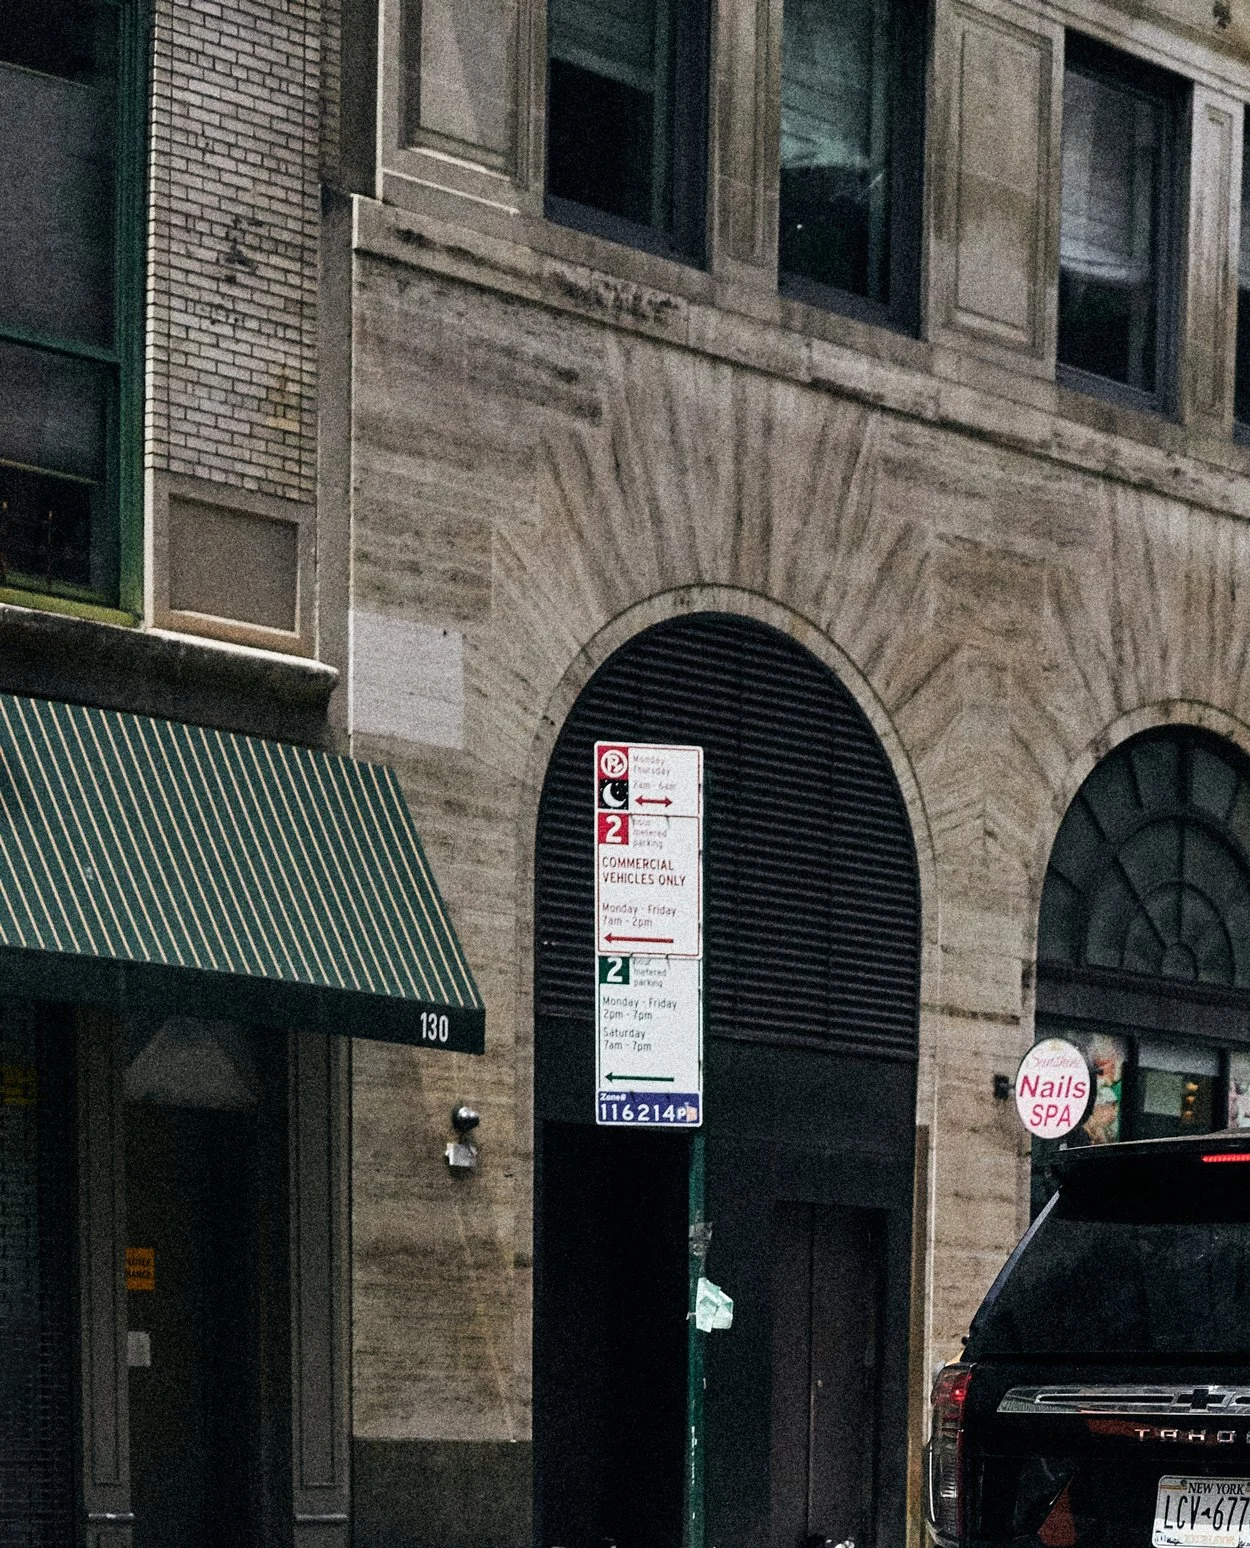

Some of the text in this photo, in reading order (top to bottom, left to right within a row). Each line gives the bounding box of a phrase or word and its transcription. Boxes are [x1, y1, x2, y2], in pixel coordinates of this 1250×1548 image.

[606, 814, 622, 843] 2
[632, 829, 667, 838] metered
[633, 840, 663, 849] parking
[602, 856, 675, 871] COMMERCIAL
[602, 871, 686, 887] VEHICLES ONLY
[602, 902, 638, 915] Monday
[648, 904, 677, 917] Friday
[603, 915, 623, 927] 7am
[632, 916, 653, 928] 2pm
[606, 957, 623, 982] 2
[633, 980, 663, 988] parking
[602, 996, 639, 1008] Monday
[648, 997, 677, 1010] Friday
[603, 1009, 623, 1020] 2pm
[633, 1010, 653, 1021] 7pm
[420, 1011, 449, 1043] 130
[603, 1027, 646, 1040] Saturday
[604, 1040, 623, 1051] 7am
[632, 1042, 652, 1053] 7pm
[1019, 1075, 1087, 1099] Nails
[601, 1103, 675, 1122] 116214
[1030, 1104, 1071, 1128] SPA
[1188, 1482, 1245, 1495] NEW YORK
